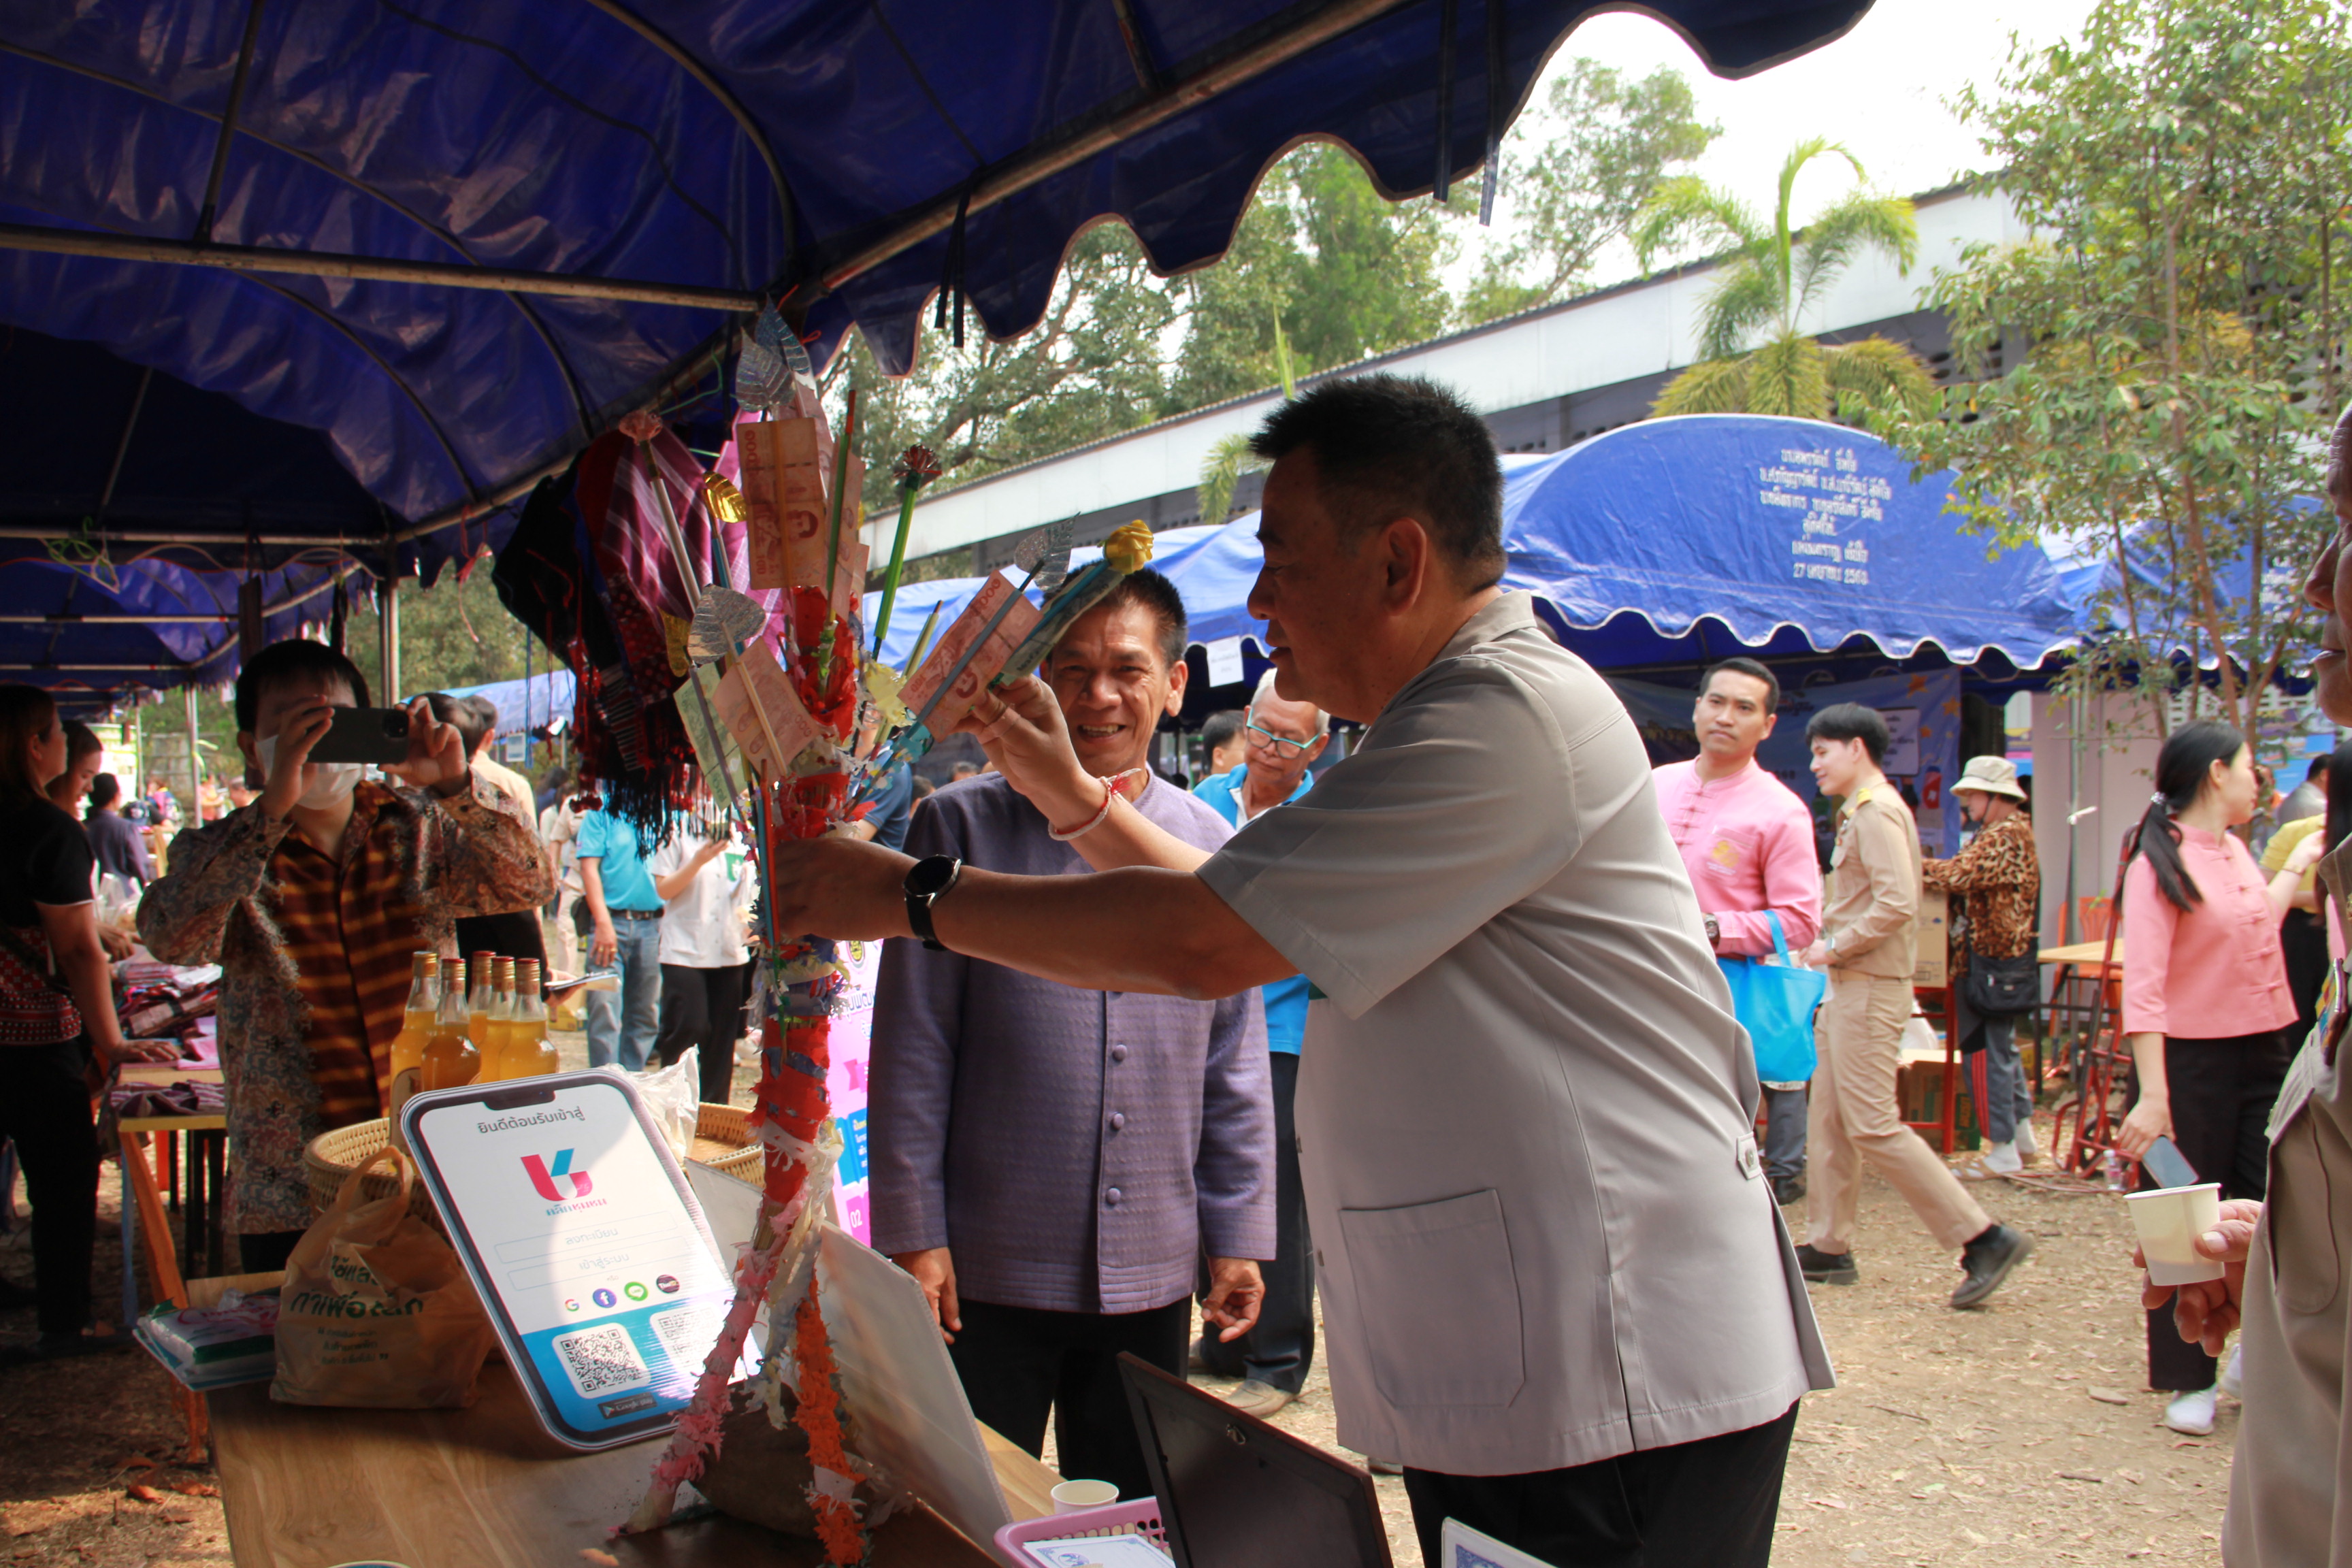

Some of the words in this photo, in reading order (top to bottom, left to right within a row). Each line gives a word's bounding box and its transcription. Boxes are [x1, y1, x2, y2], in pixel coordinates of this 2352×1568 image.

[477, 1106, 585, 1134] ยินดีต้อนรับเข้าสู่
[850, 1209, 863, 1228] 02
[565, 1228, 619, 1245] ลงทะเบียน
[578, 1253, 630, 1271] เข้าสู่ระบบ
